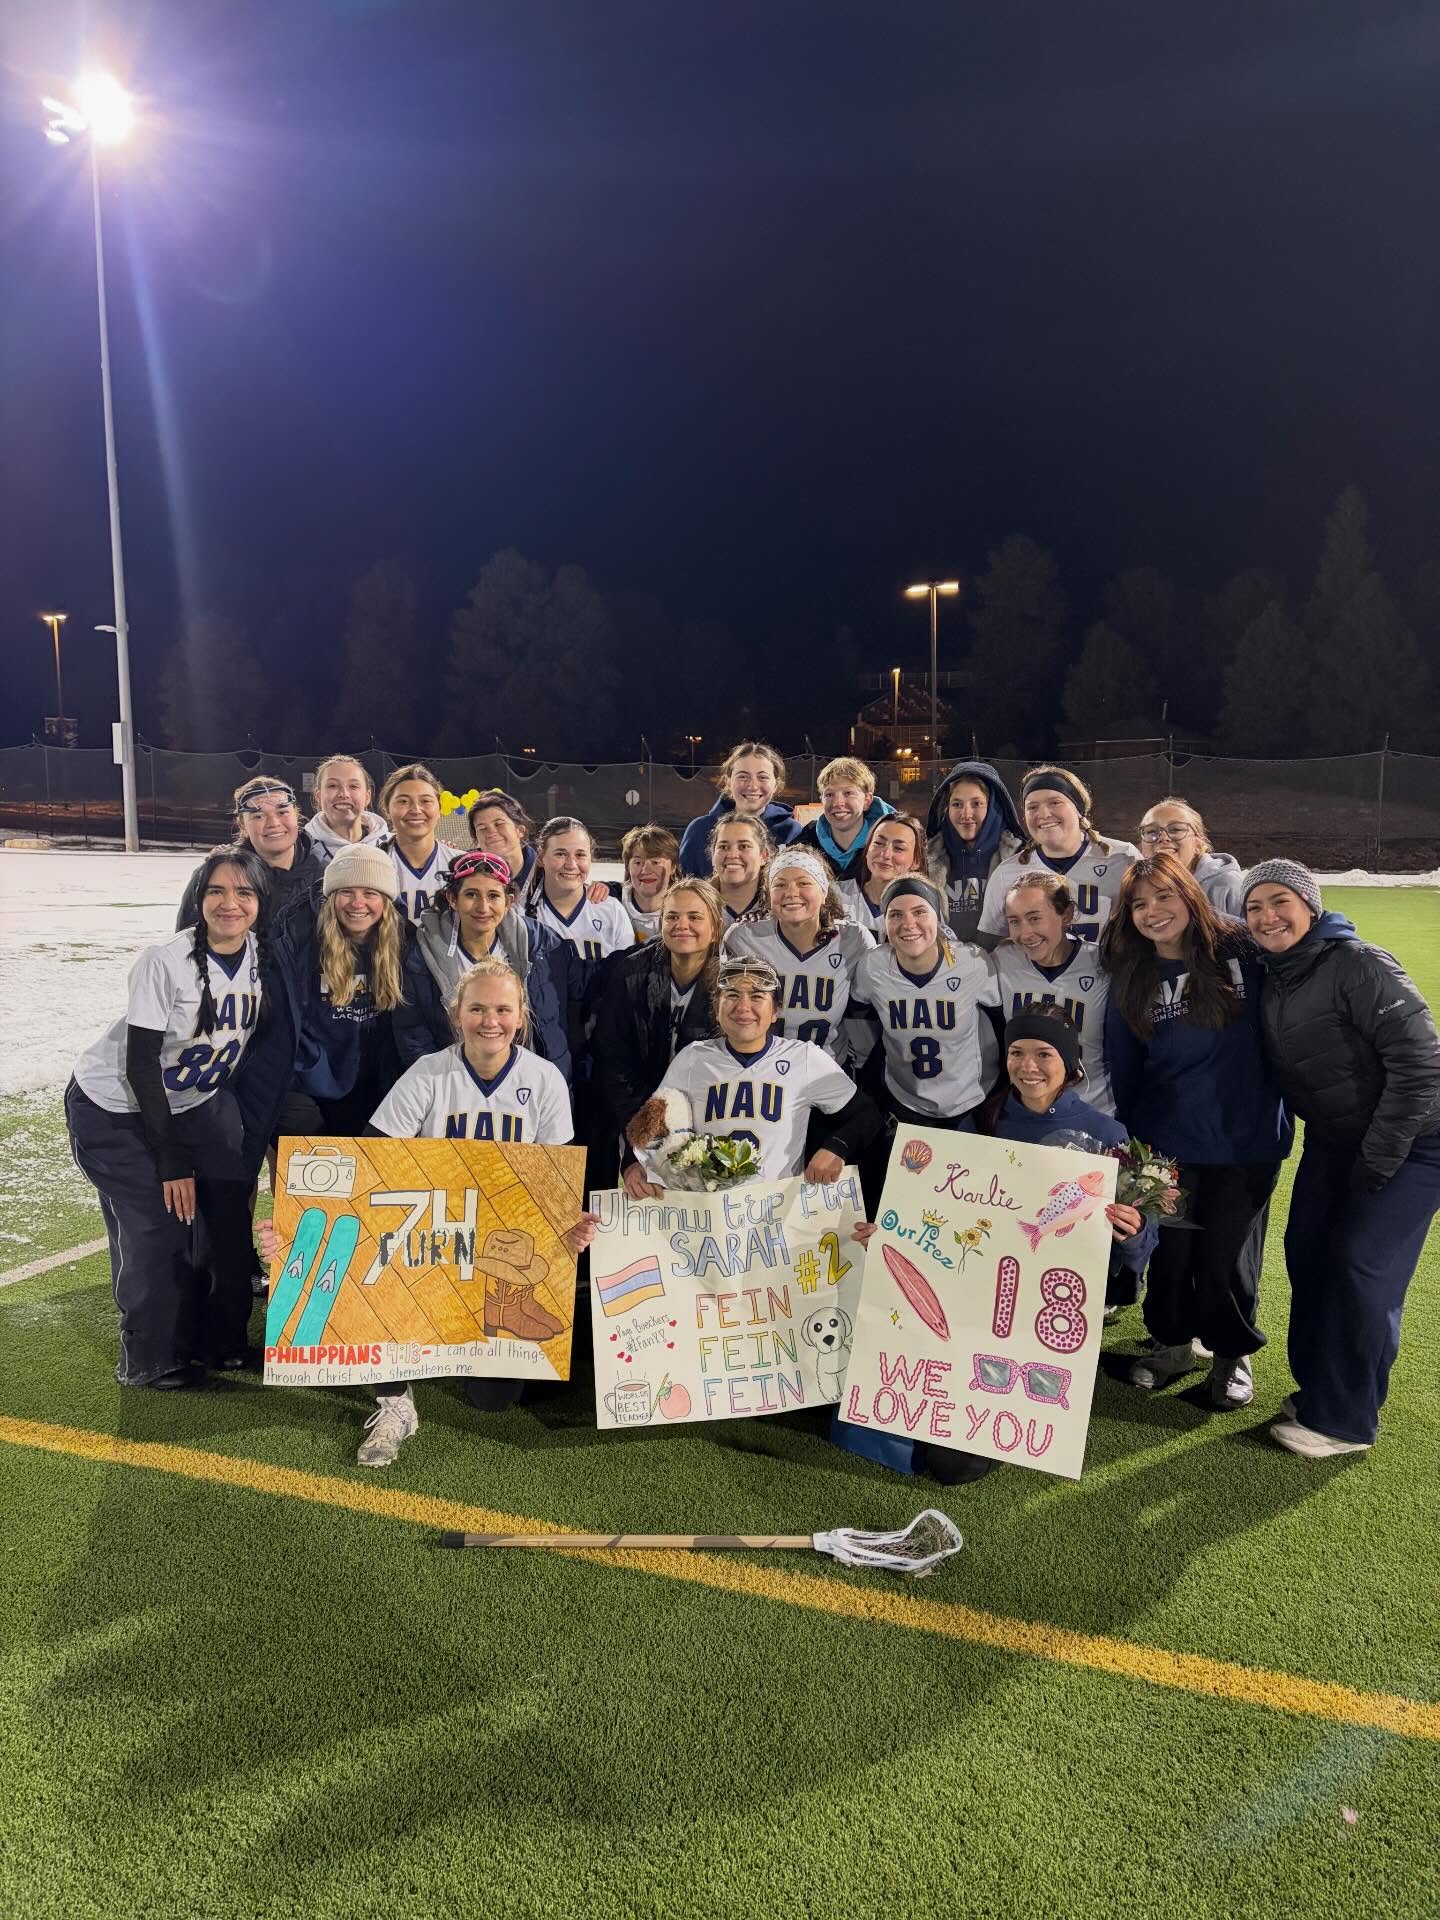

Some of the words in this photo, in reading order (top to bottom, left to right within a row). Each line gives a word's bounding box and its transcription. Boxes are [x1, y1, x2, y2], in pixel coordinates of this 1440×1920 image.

[211, 993, 257, 1030] AU
[889, 998, 956, 1031] NAU
[910, 1036, 943, 1080] 8
[704, 1081, 784, 1123] NAU
[934, 1163, 1024, 1211] Karlie
[670, 1222, 791, 1277] SARAH
[881, 1209, 917, 1239] Our
[915, 1221, 956, 1270] Prez
[794, 1231, 853, 1295] #2
[695, 1285, 793, 1329] FEIN
[992, 1255, 1089, 1355] 18
[265, 1344, 382, 1366] PHILIPPIANS
[447, 1344, 466, 1356] can
[469, 1339, 484, 1357] do
[487, 1339, 501, 1357] all
[508, 1342, 545, 1364] things
[699, 1328, 799, 1373] FEIN
[266, 1368, 311, 1386] through
[317, 1367, 353, 1383] Christ
[359, 1369, 382, 1383] who
[456, 1363, 473, 1375] me
[703, 1370, 805, 1416] FEIN
[879, 1352, 951, 1398] WE
[617, 1402, 646, 1413] BEST
[847, 1385, 956, 1438] LOVE
[965, 1404, 1054, 1458] YOU
